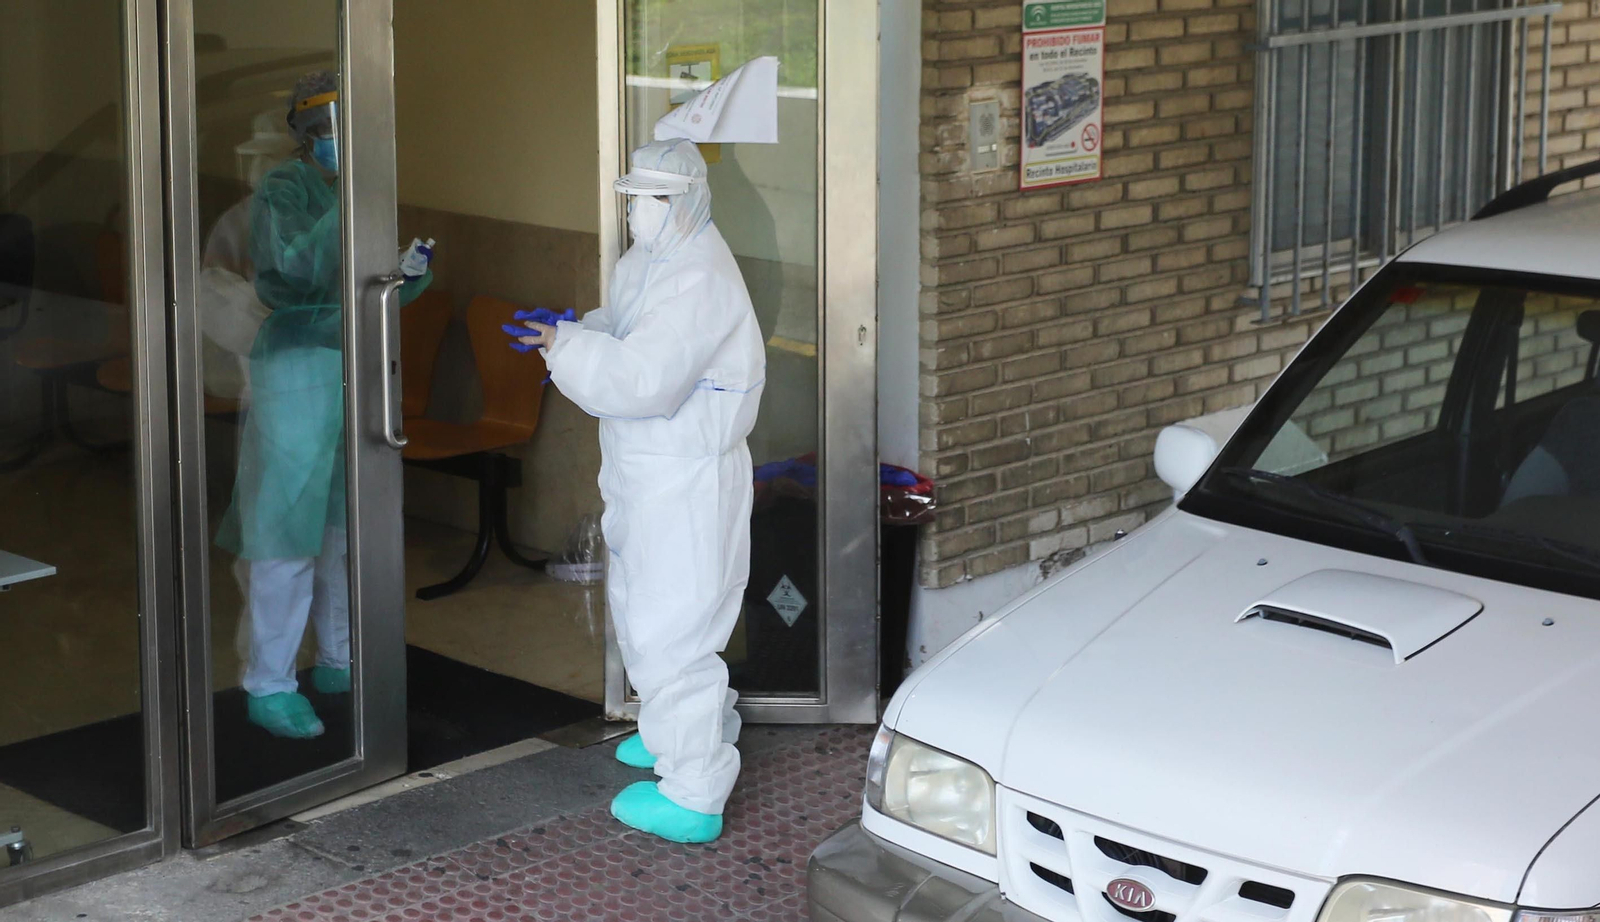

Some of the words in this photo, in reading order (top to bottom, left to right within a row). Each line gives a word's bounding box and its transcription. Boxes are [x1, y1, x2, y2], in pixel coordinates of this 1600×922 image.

[1027, 35, 1071, 48] PROHIBIDO
[1073, 33, 1100, 44] FUMAR
[1041, 50, 1058, 60] todo
[1060, 48, 1067, 58] el
[1070, 46, 1098, 56] Recinto
[1026, 166, 1053, 178] Recinto
[1055, 161, 1097, 175] Hospitalario
[1114, 883, 1146, 907] KIA
